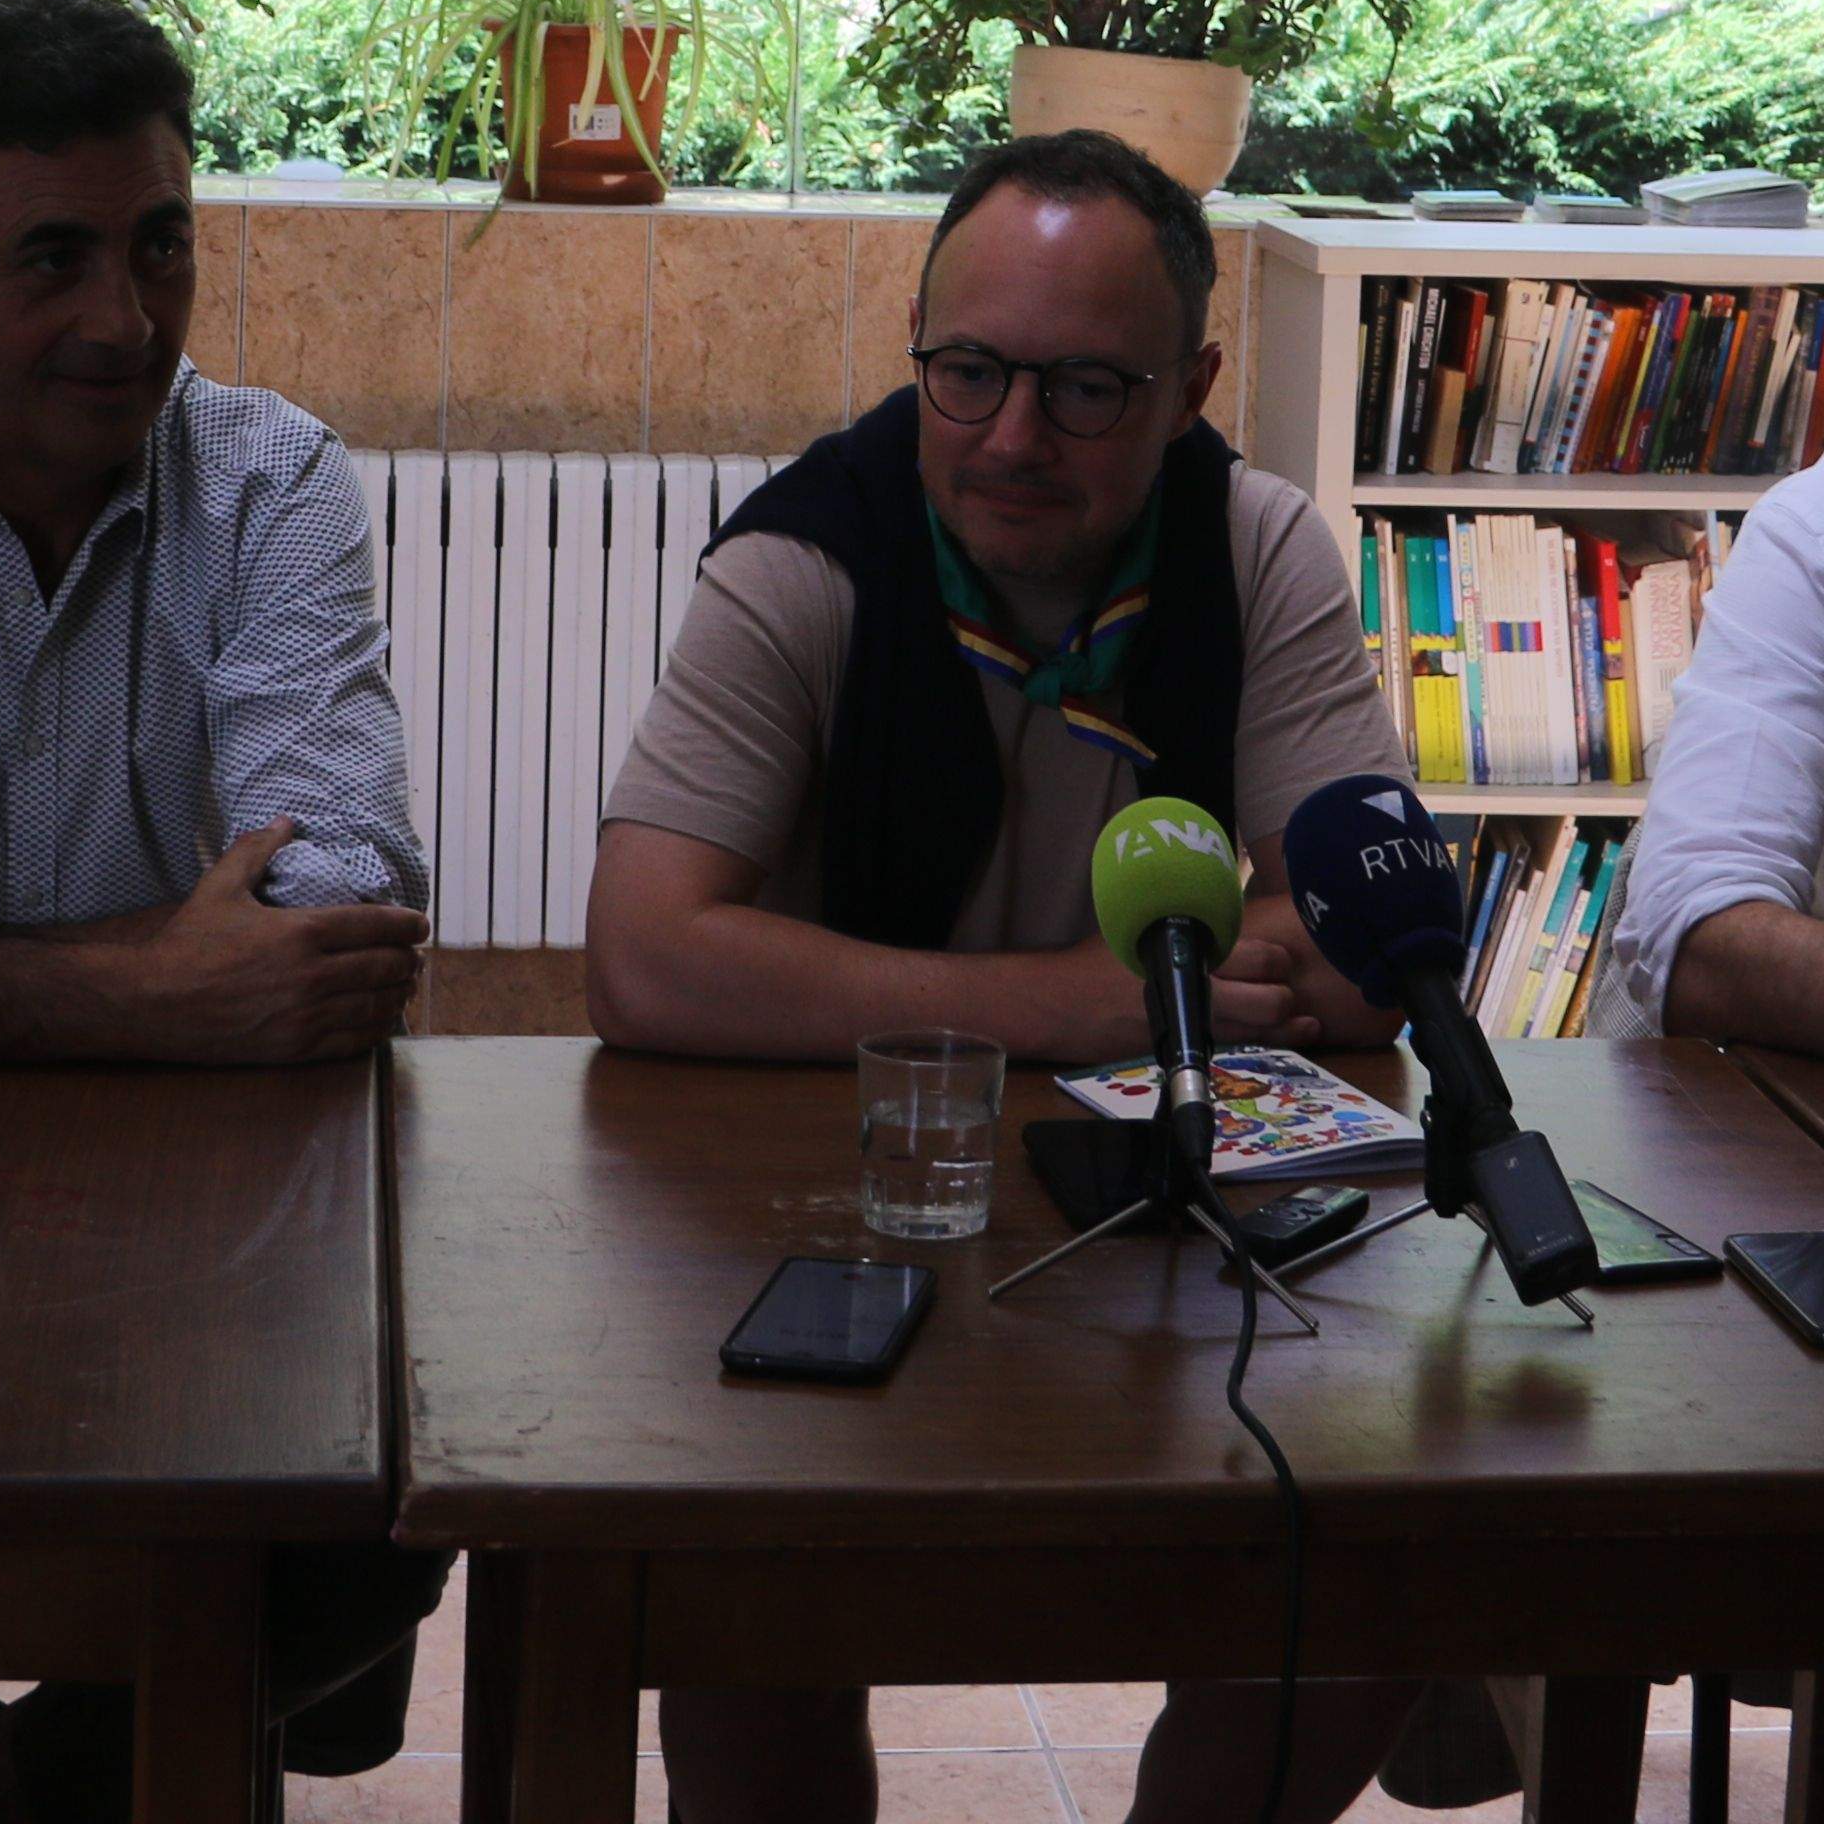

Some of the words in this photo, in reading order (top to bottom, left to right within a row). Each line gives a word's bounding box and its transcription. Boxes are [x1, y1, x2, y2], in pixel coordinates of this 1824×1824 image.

[1423, 287, 1438, 324] MICHAEL
[1671, 572, 1682, 658] CATALANA
[1359, 837, 1453, 880] RTVA
